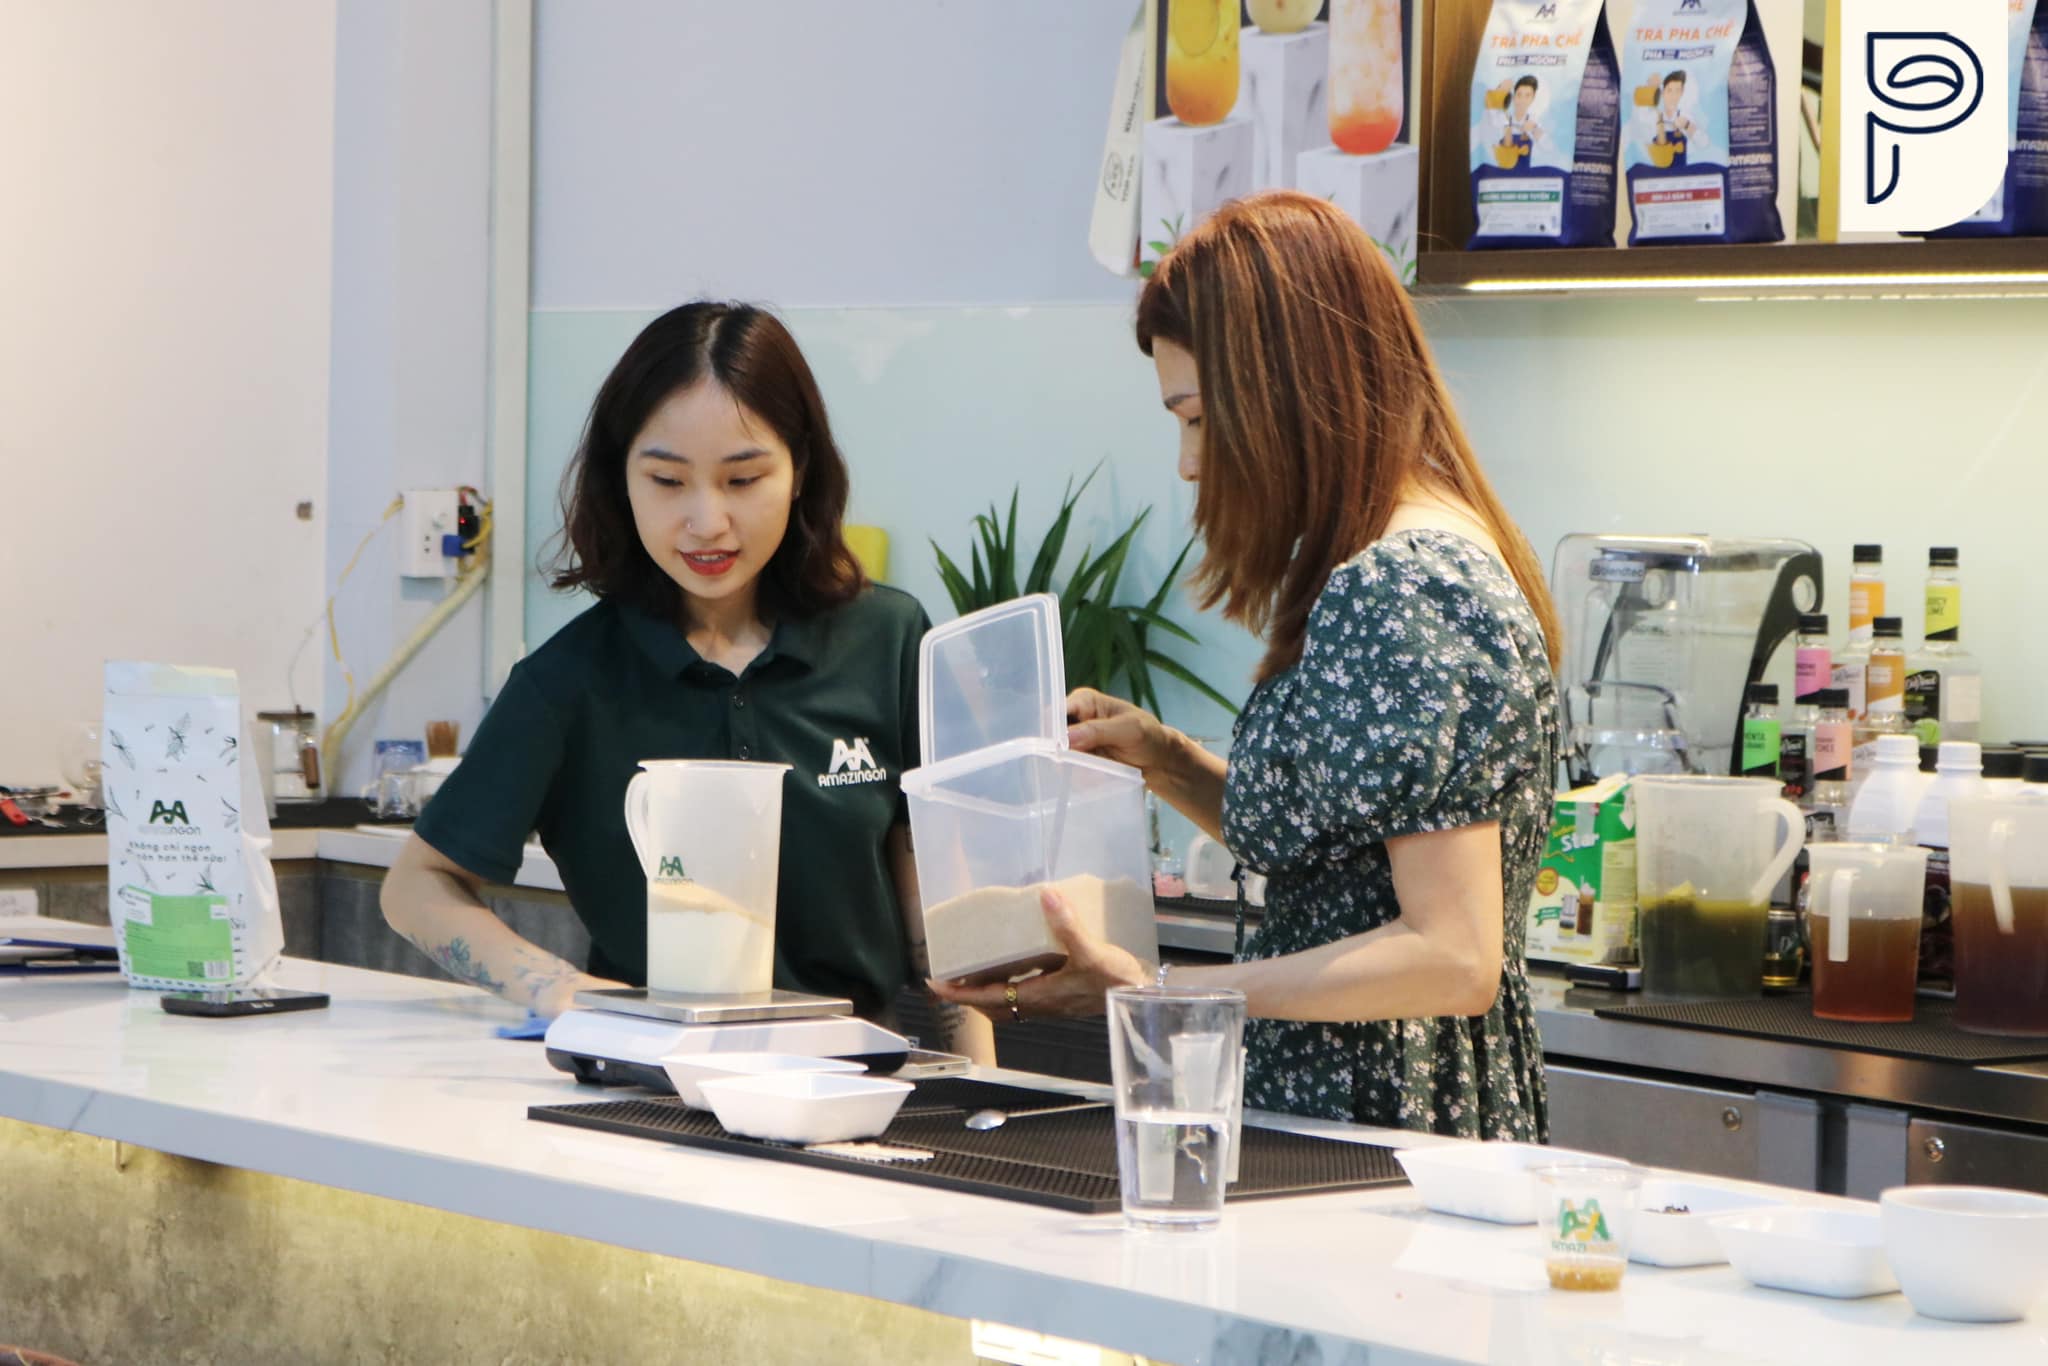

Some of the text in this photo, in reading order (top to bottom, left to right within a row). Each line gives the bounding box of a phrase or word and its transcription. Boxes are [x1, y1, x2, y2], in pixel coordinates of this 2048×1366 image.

[1520, 33, 1550, 48] PHA
[1668, 26, 1700, 41] PHA
[817, 767, 887, 788] AMAZINGON
[1561, 833, 1600, 851] Star
